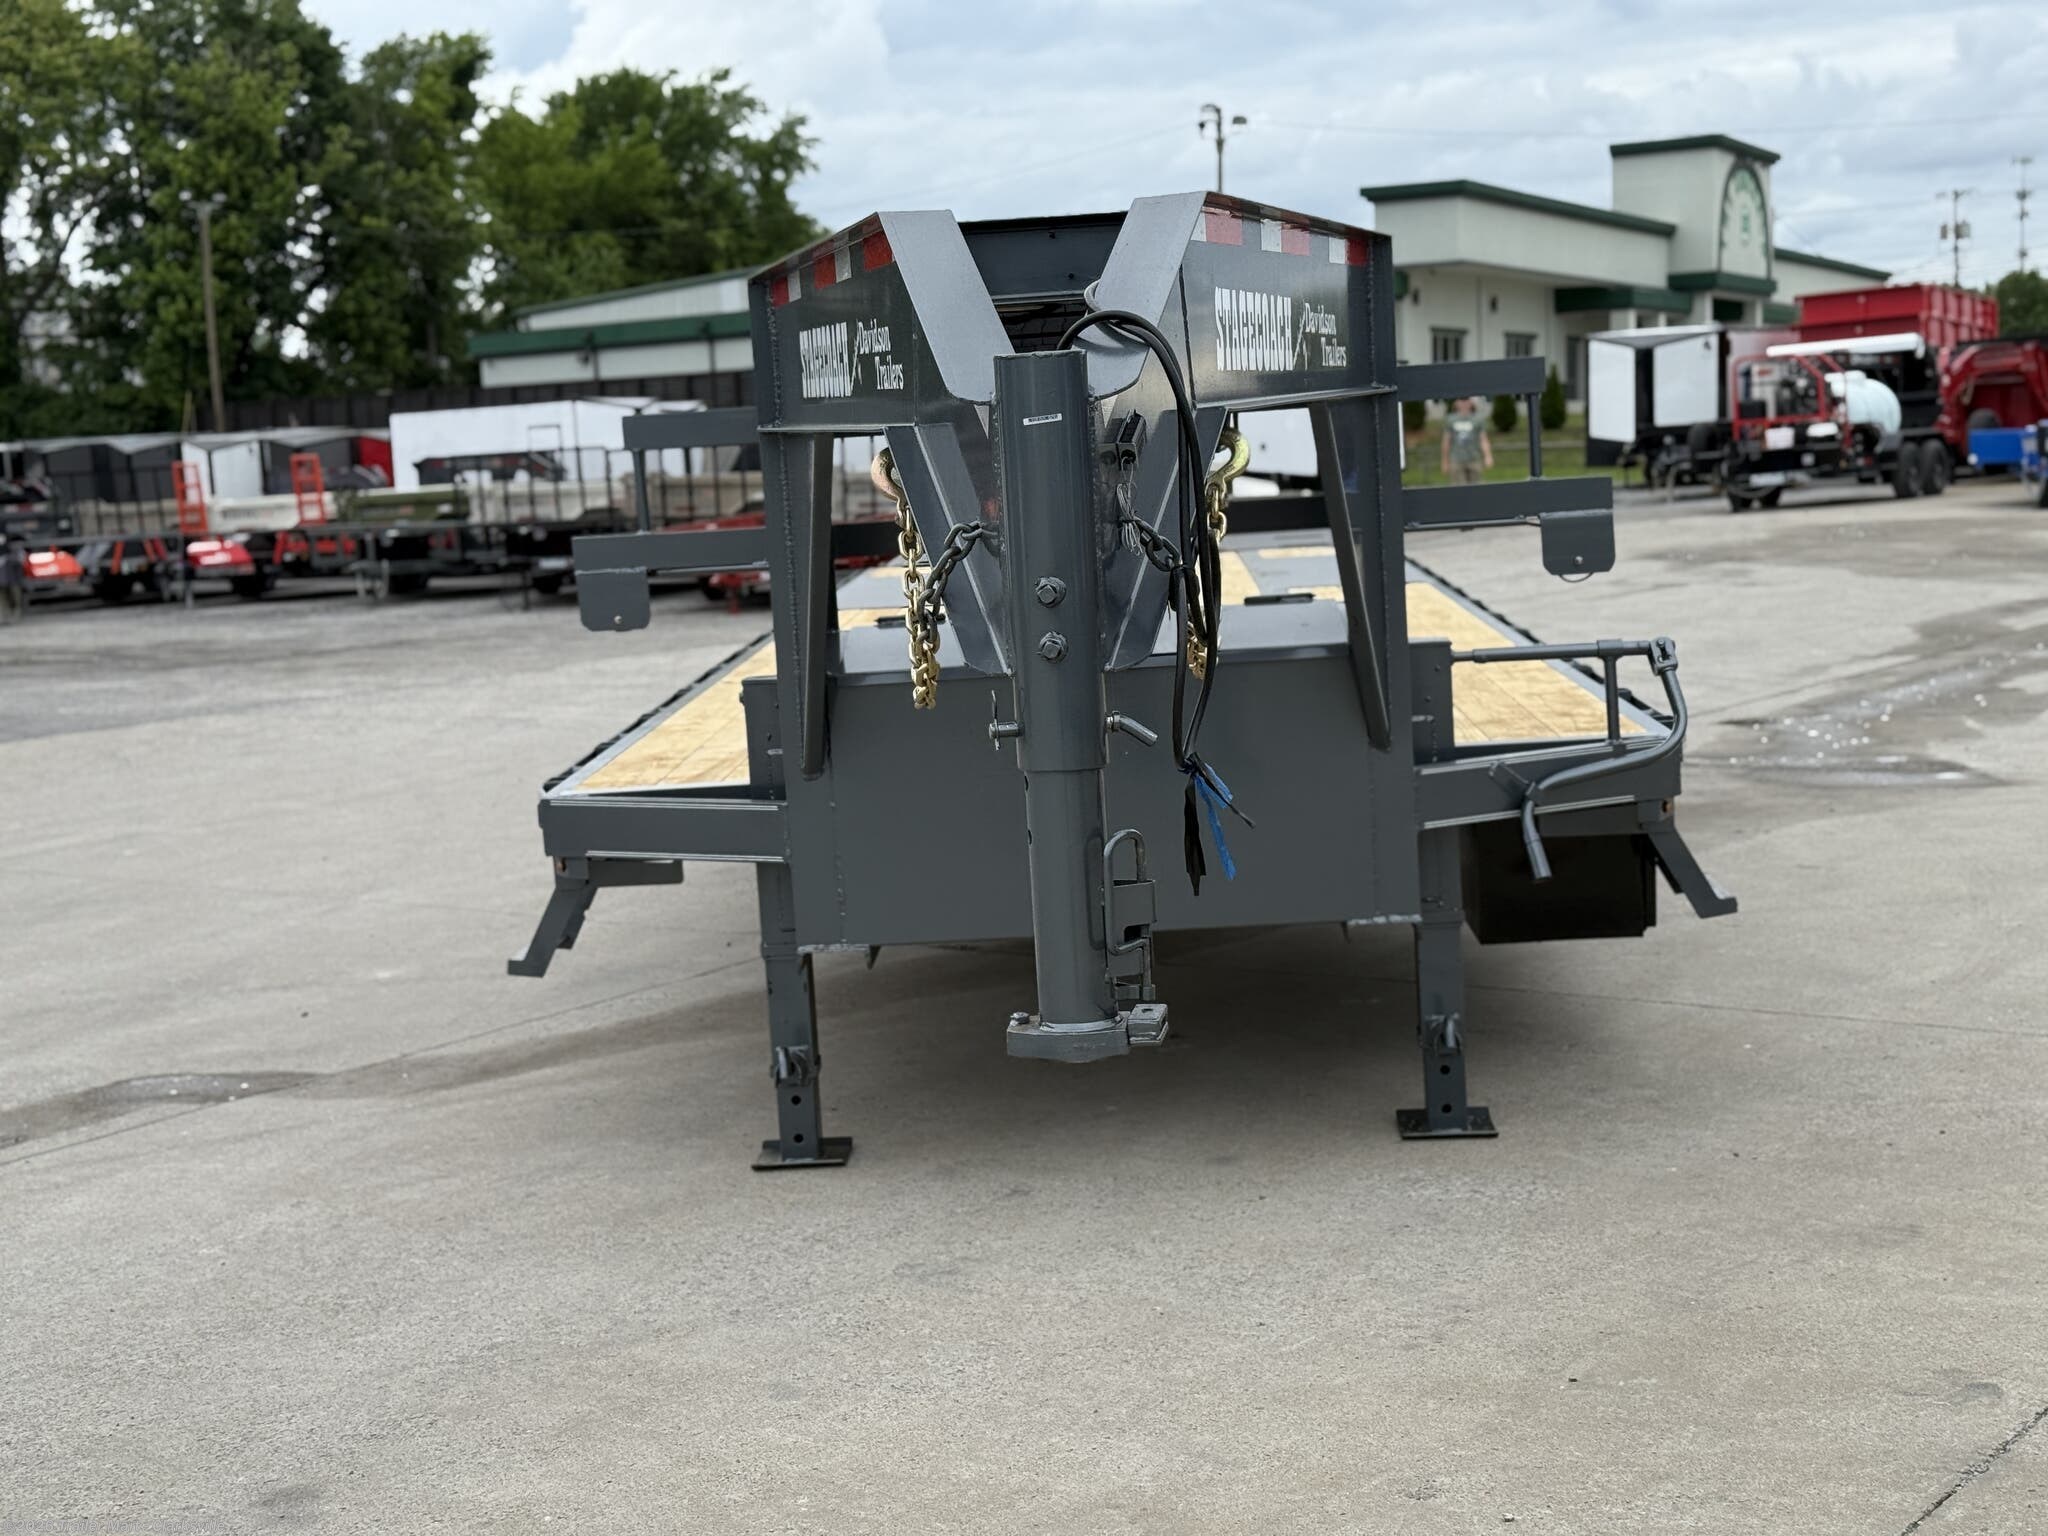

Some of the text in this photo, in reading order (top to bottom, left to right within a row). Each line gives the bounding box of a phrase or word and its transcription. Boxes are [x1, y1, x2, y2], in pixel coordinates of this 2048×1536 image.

[858, 318, 891, 354] Davidson
[1214, 286, 1293, 371] STAGECOACH
[1304, 302, 1337, 335] Davidson
[799, 321, 851, 398] STAGECOACH
[1320, 336, 1347, 367] Trailers
[874, 355, 904, 390] Trailers
